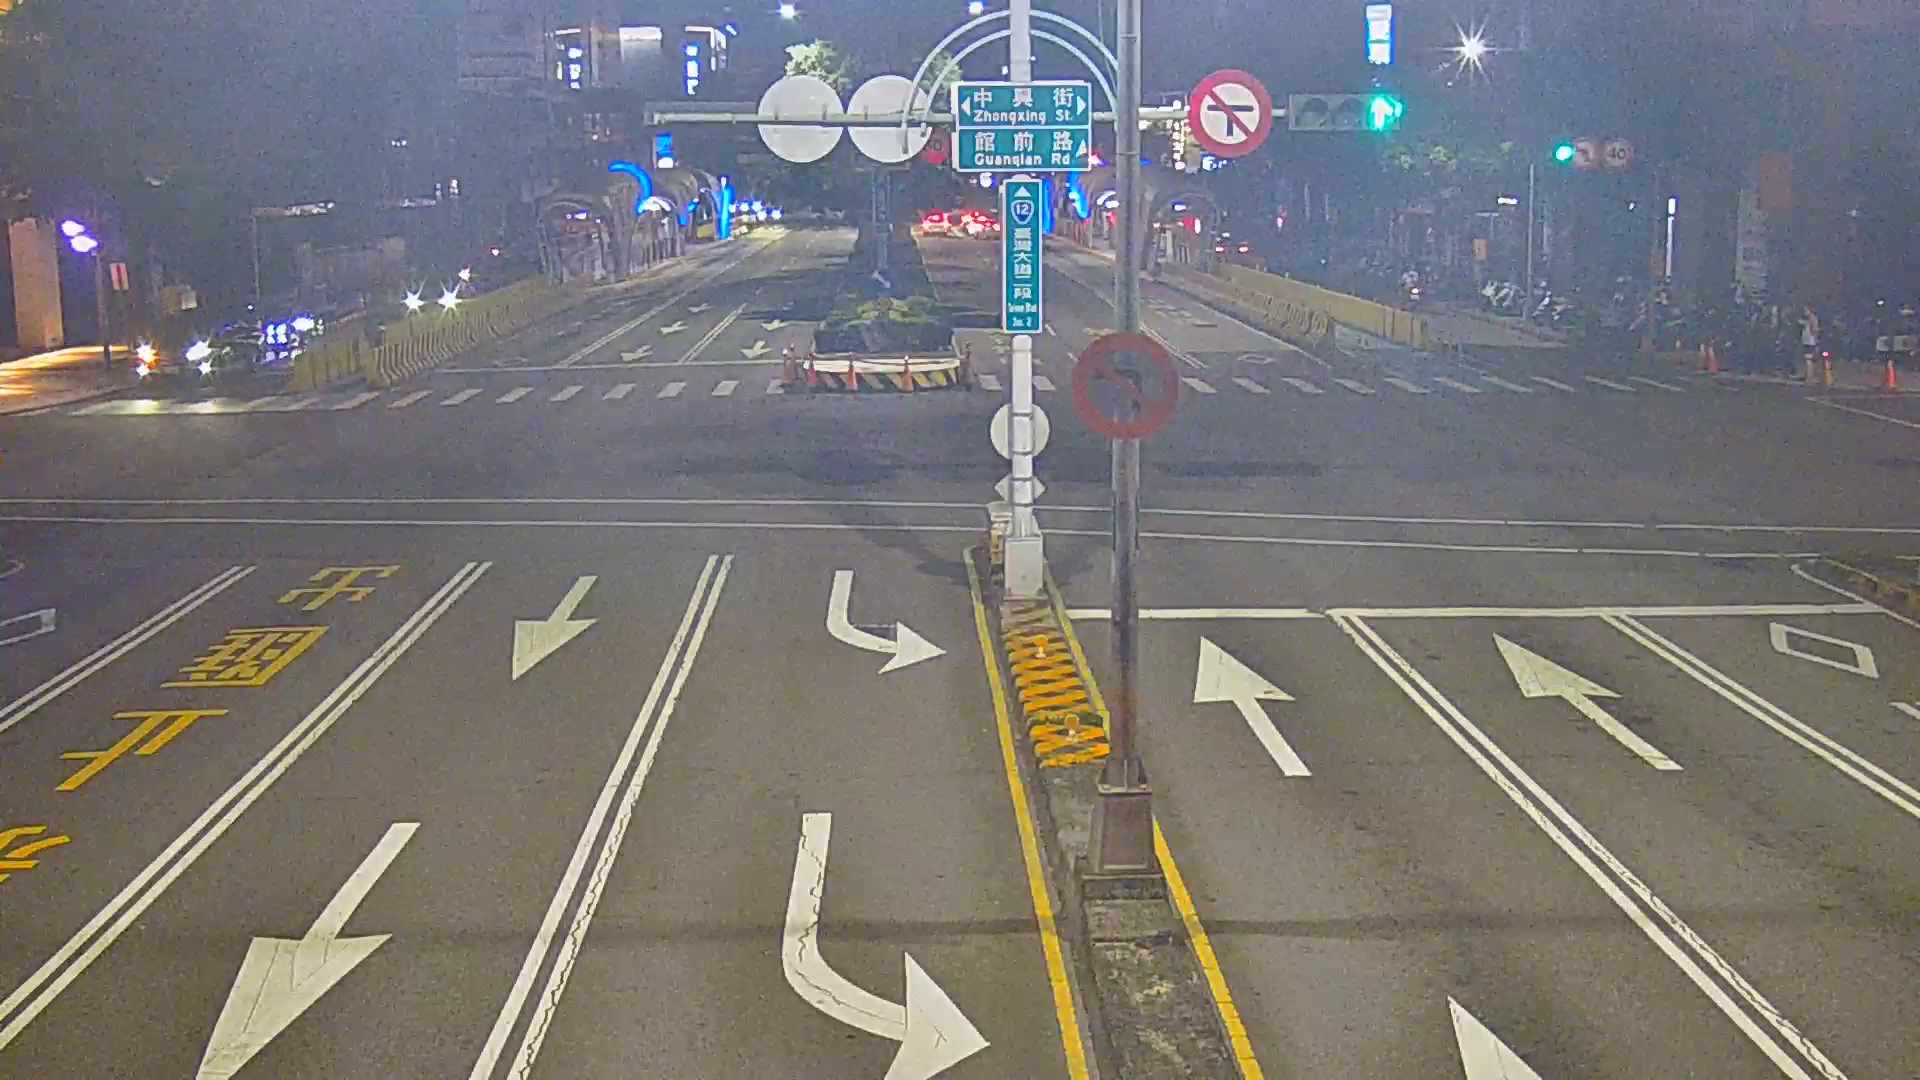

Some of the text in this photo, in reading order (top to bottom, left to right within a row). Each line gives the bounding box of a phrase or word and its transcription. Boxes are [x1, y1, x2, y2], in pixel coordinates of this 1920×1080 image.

[974, 87, 1073, 108] 中興街
[973, 109, 1047, 124] Zhongxing
[975, 131, 1073, 152] 館前路
[974, 153, 1042, 167] Guanqian
[1015, 203, 1031, 215] 12
